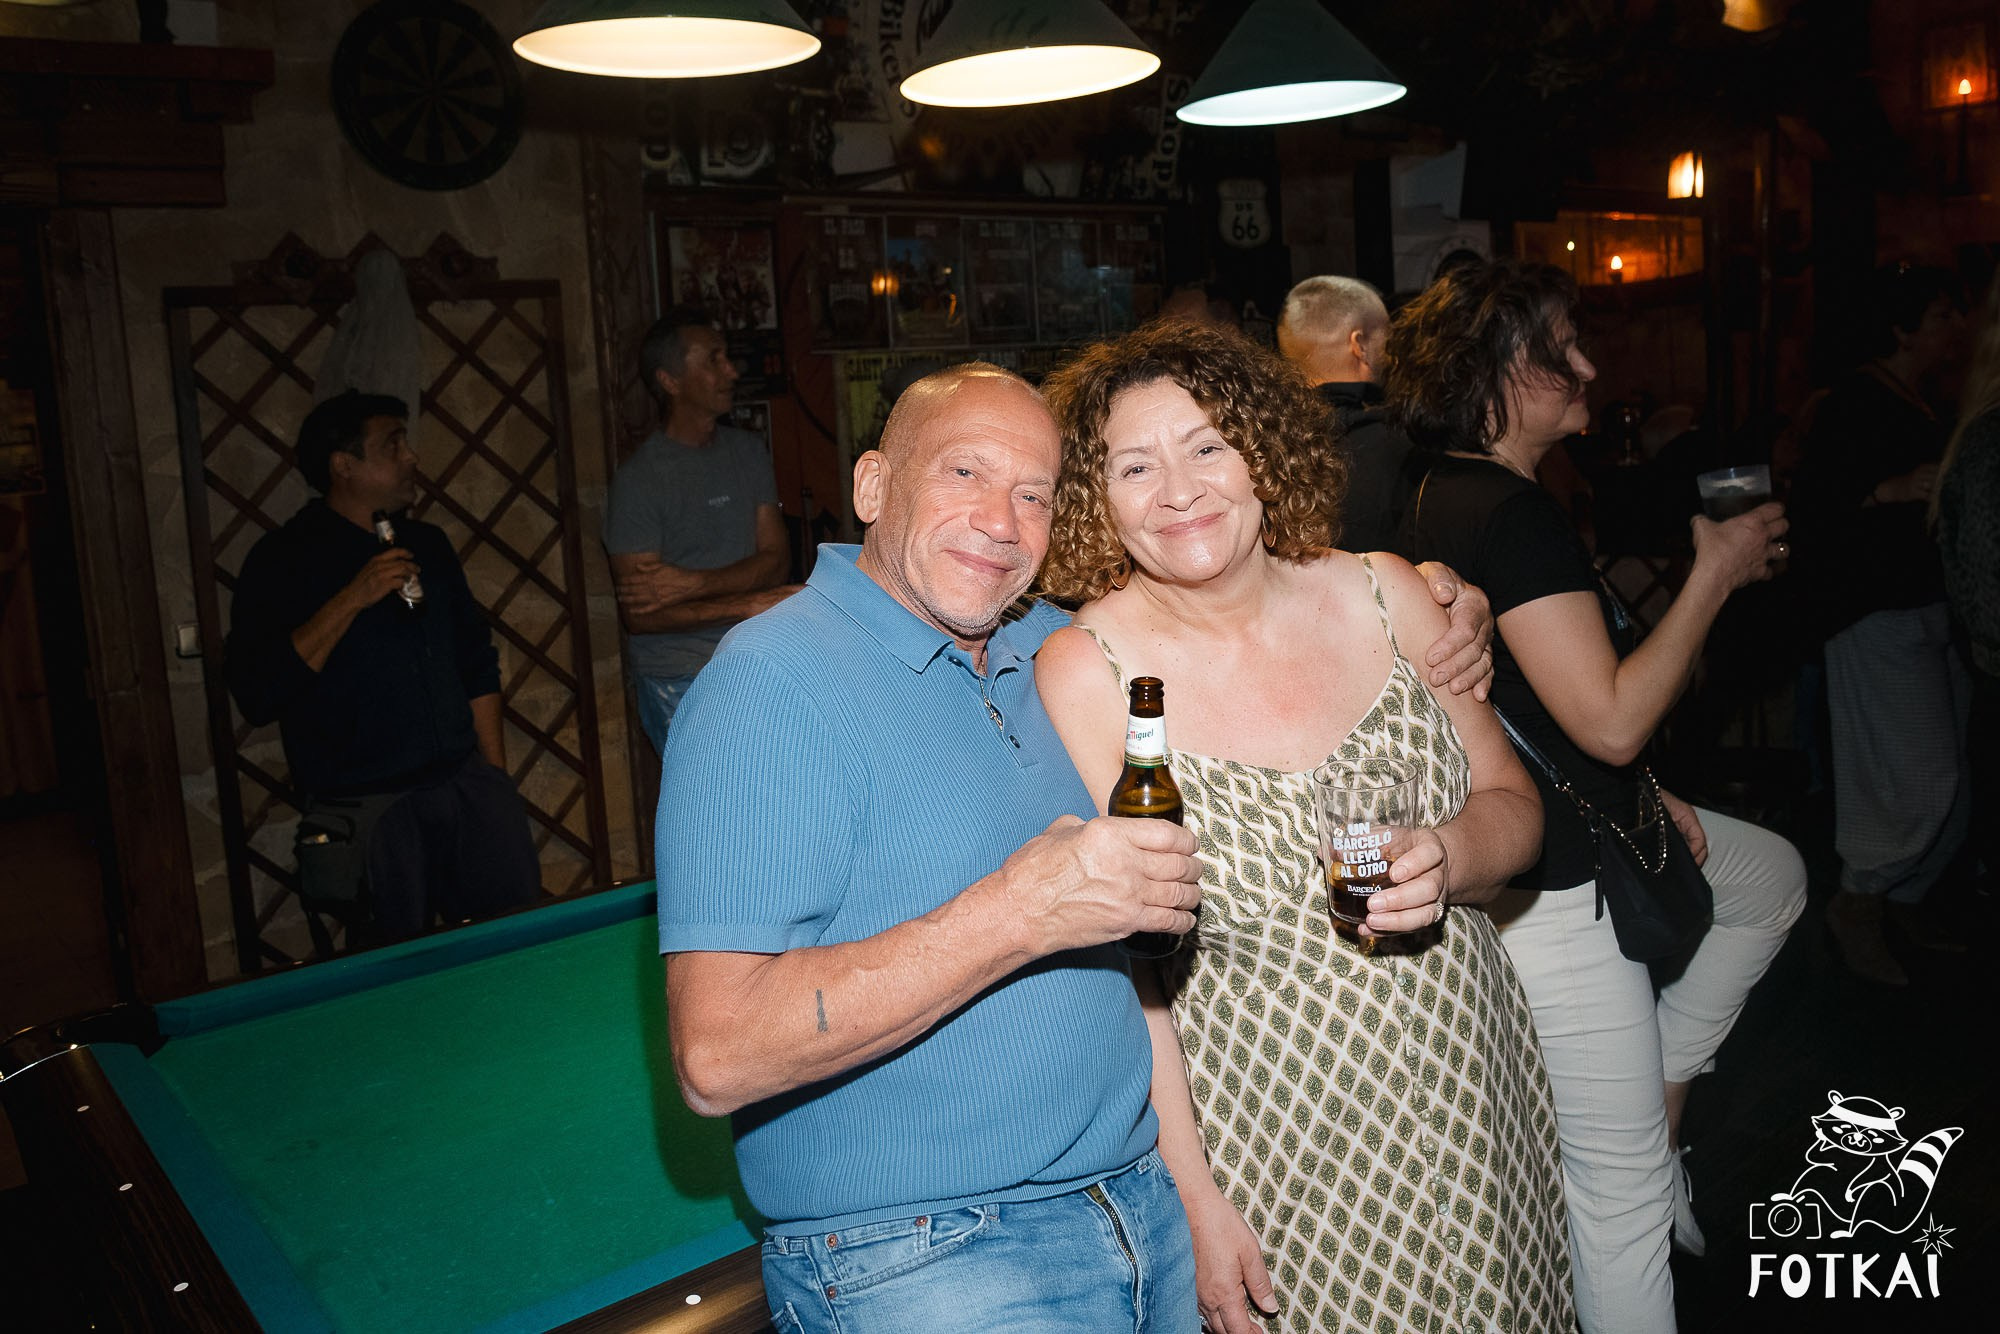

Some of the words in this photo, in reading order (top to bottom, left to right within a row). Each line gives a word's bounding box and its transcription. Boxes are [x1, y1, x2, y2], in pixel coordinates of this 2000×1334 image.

[1232, 215, 1260, 240] 66
[1347, 821, 1371, 837] UN
[1333, 829, 1392, 851] BARCELÓ
[1341, 866, 1354, 878] AL
[1357, 860, 1388, 878] OTRO
